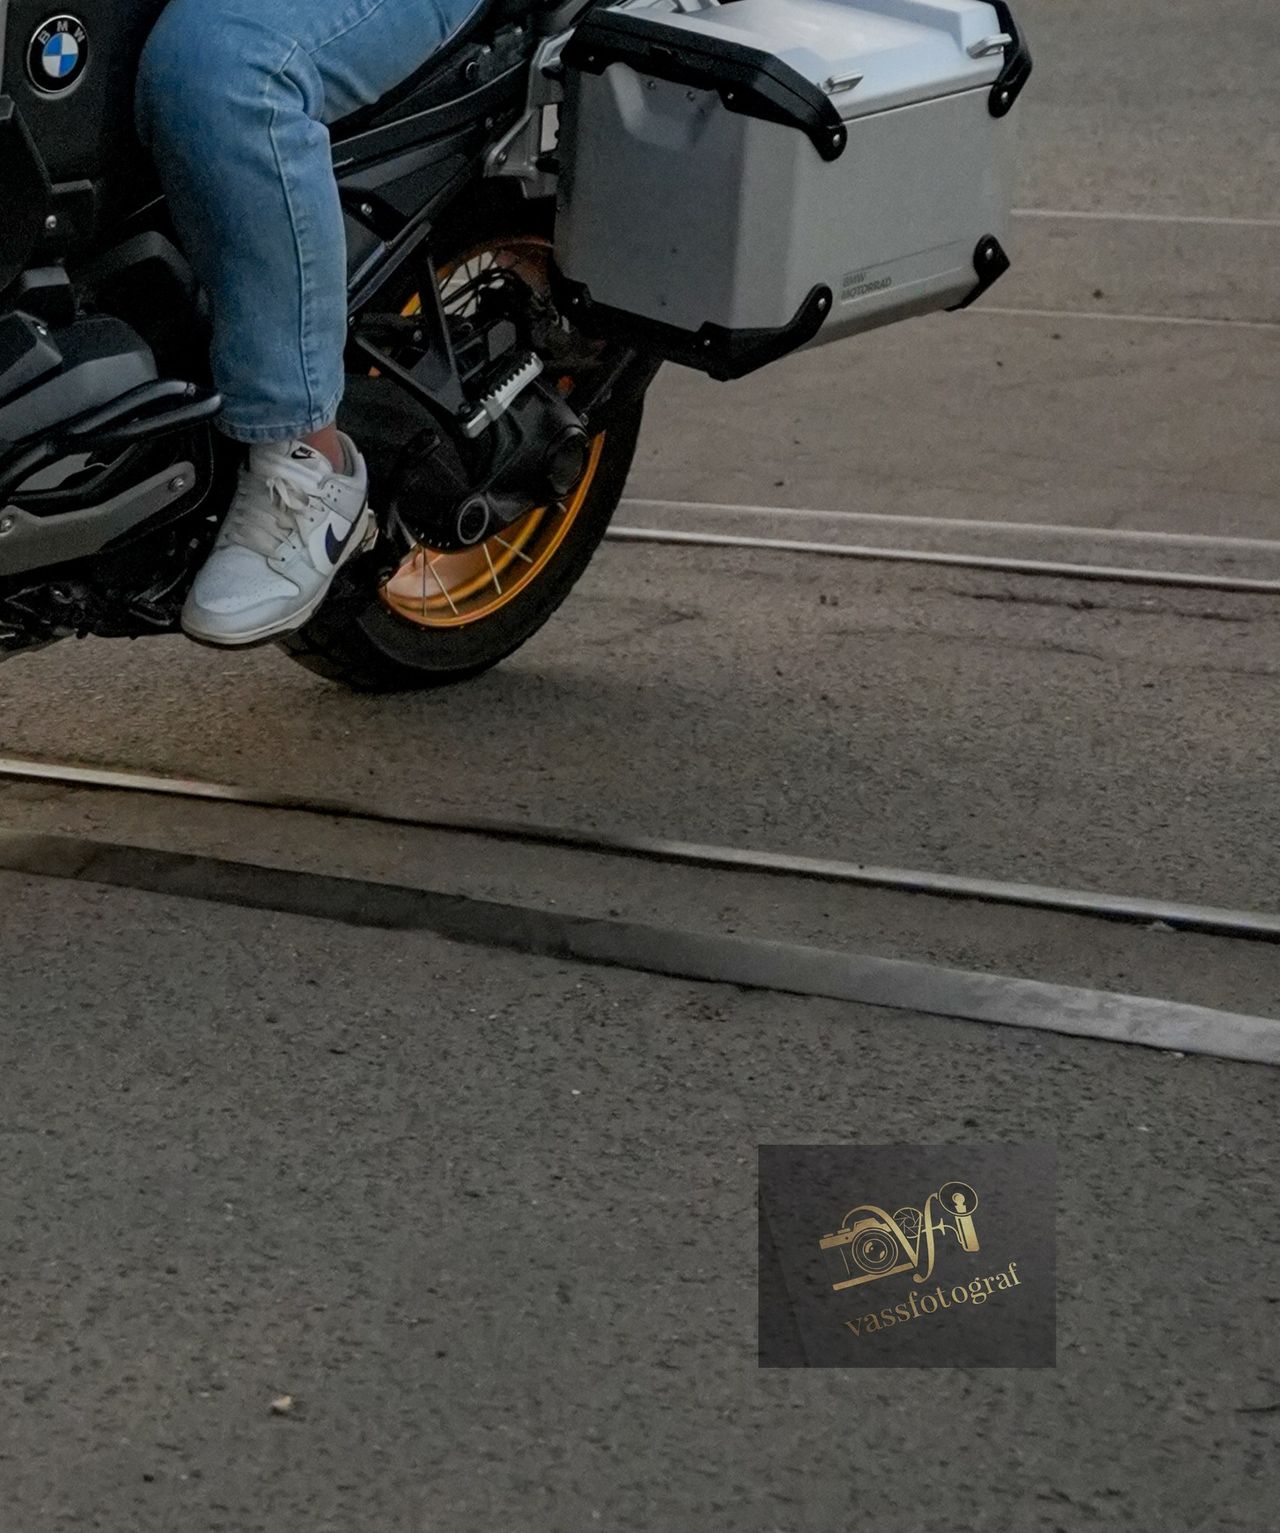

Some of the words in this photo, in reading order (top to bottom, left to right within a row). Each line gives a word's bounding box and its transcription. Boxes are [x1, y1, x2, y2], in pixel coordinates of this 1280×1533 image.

[37, 20, 86, 45] BMW
[840, 276, 892, 301] MOTORRAD
[842, 271, 867, 288] BMW
